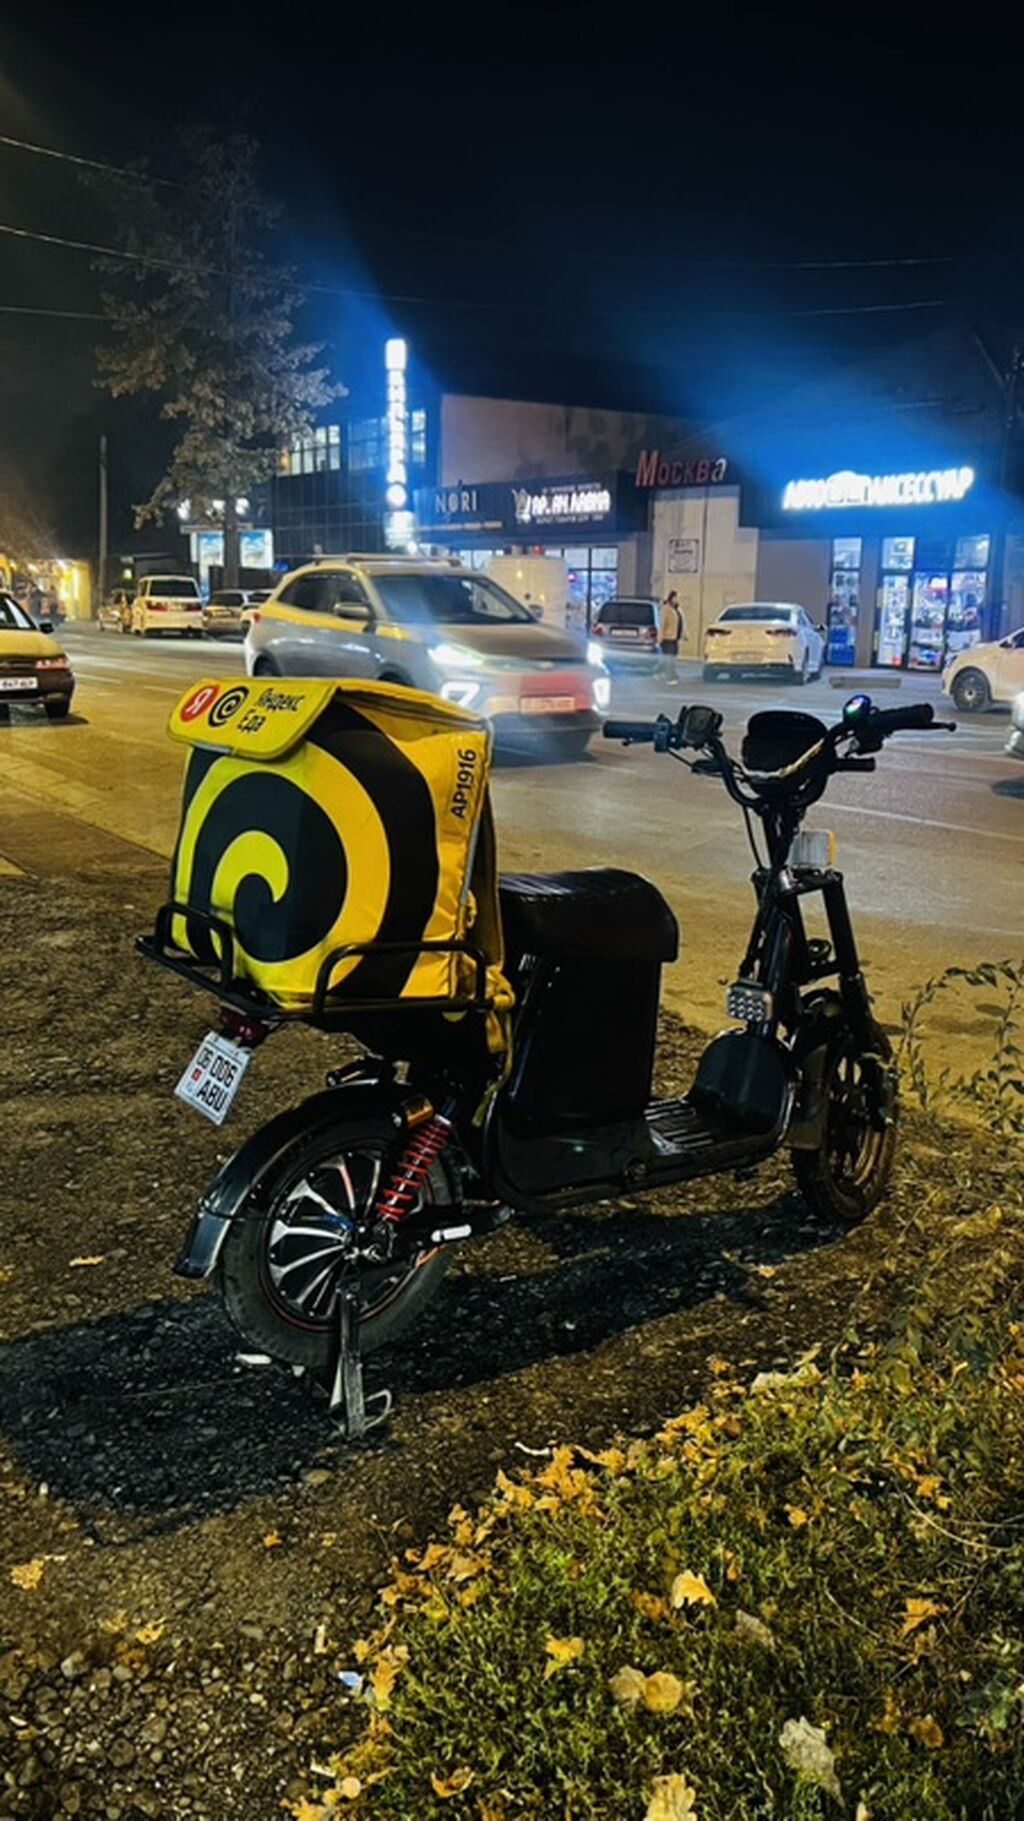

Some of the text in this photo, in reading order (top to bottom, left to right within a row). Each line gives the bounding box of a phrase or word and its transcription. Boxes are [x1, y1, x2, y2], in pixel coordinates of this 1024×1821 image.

[435, 490, 477, 513] NORI
[257, 687, 306, 711] Яндекс
[237, 709, 266, 733] Еда
[450, 748, 477, 819] AP1916
[196, 1080, 228, 1112] ABU
